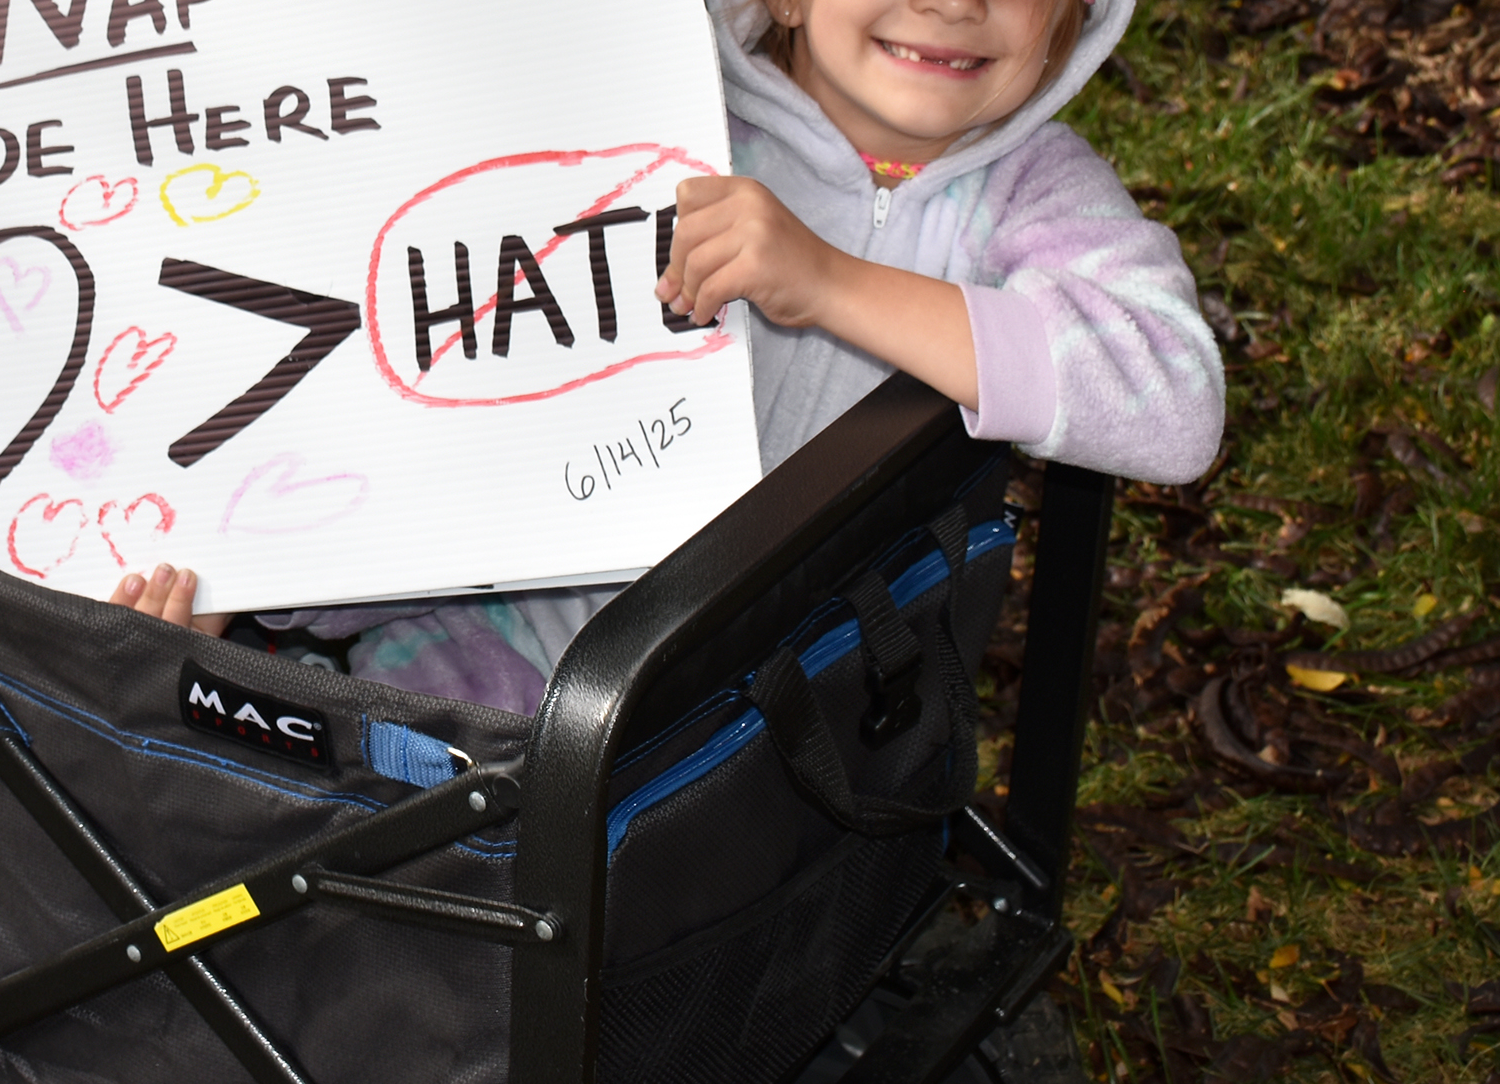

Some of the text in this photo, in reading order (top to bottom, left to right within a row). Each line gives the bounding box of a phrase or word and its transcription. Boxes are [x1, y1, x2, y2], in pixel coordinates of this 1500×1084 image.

[125, 69, 382, 168] HERE
[564, 397, 692, 501] 6/14/25
[188, 681, 316, 742] MAC
